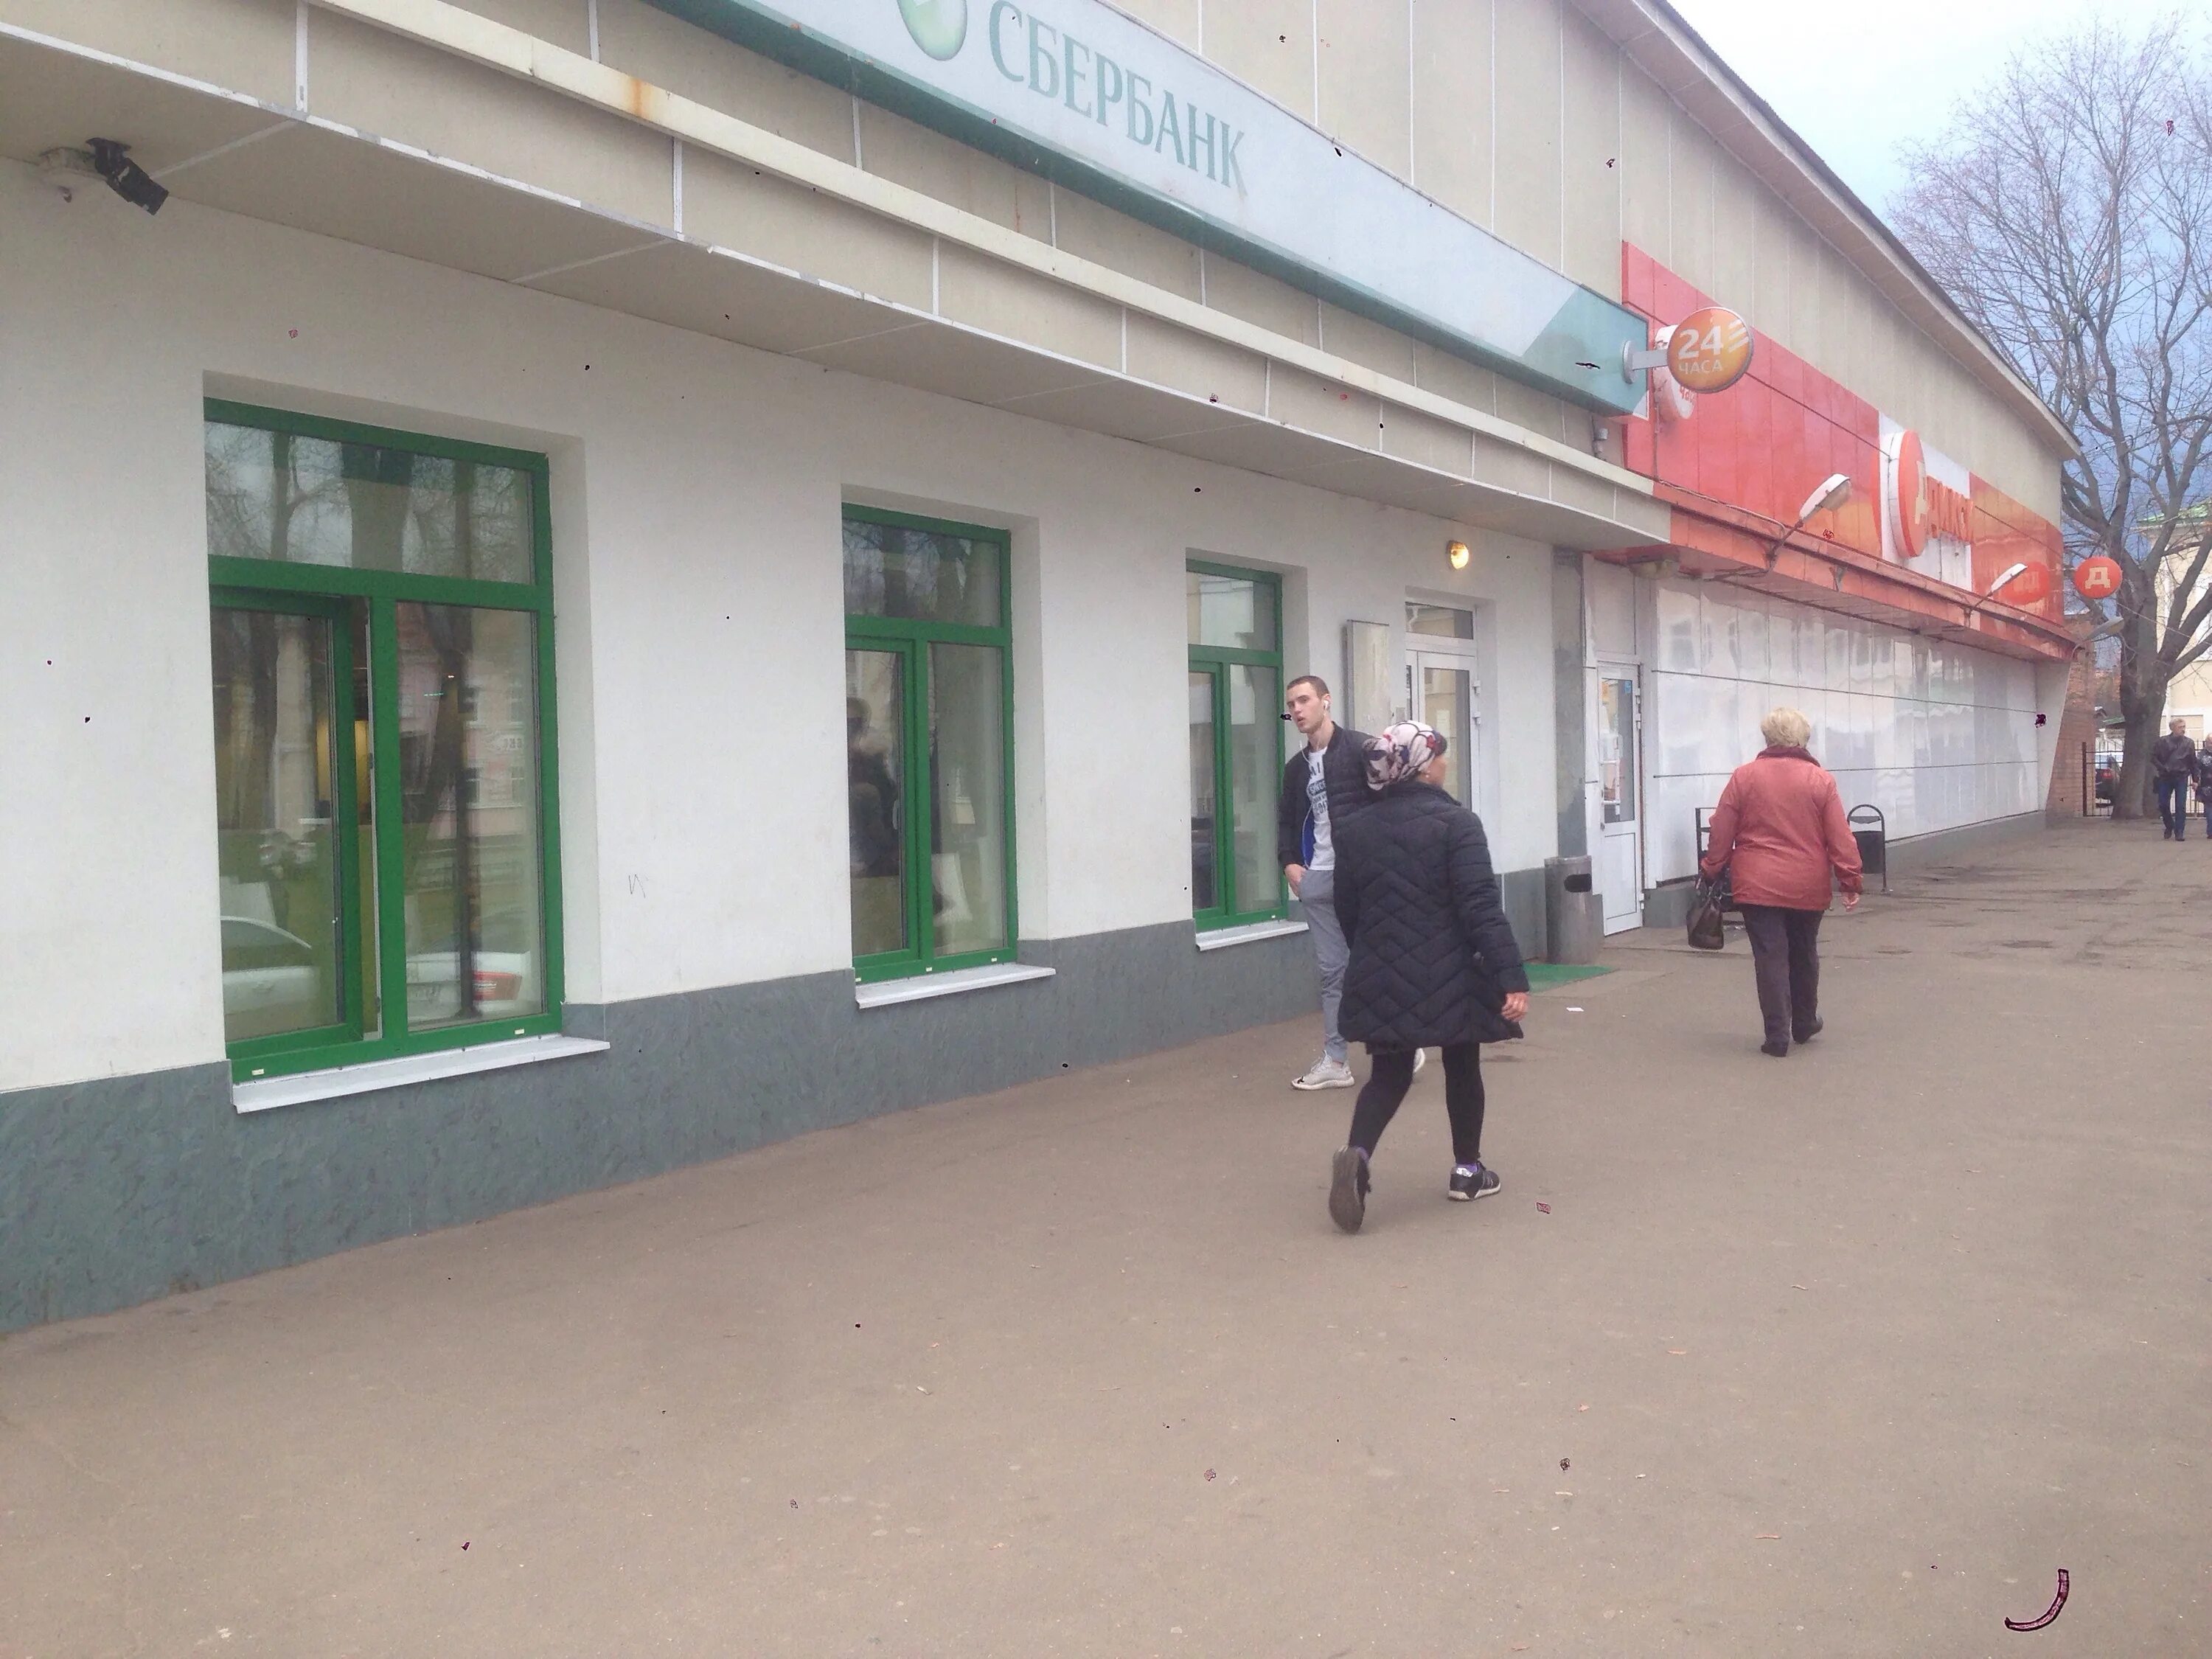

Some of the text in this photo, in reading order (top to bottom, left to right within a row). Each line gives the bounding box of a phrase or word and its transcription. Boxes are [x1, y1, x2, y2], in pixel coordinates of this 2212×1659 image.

[989, 0, 1248, 197] СБЕРБАНК
[1678, 326, 1724, 359] 24
[1678, 359, 1723, 375] ЧАСА
[2084, 566, 2111, 589] Д
